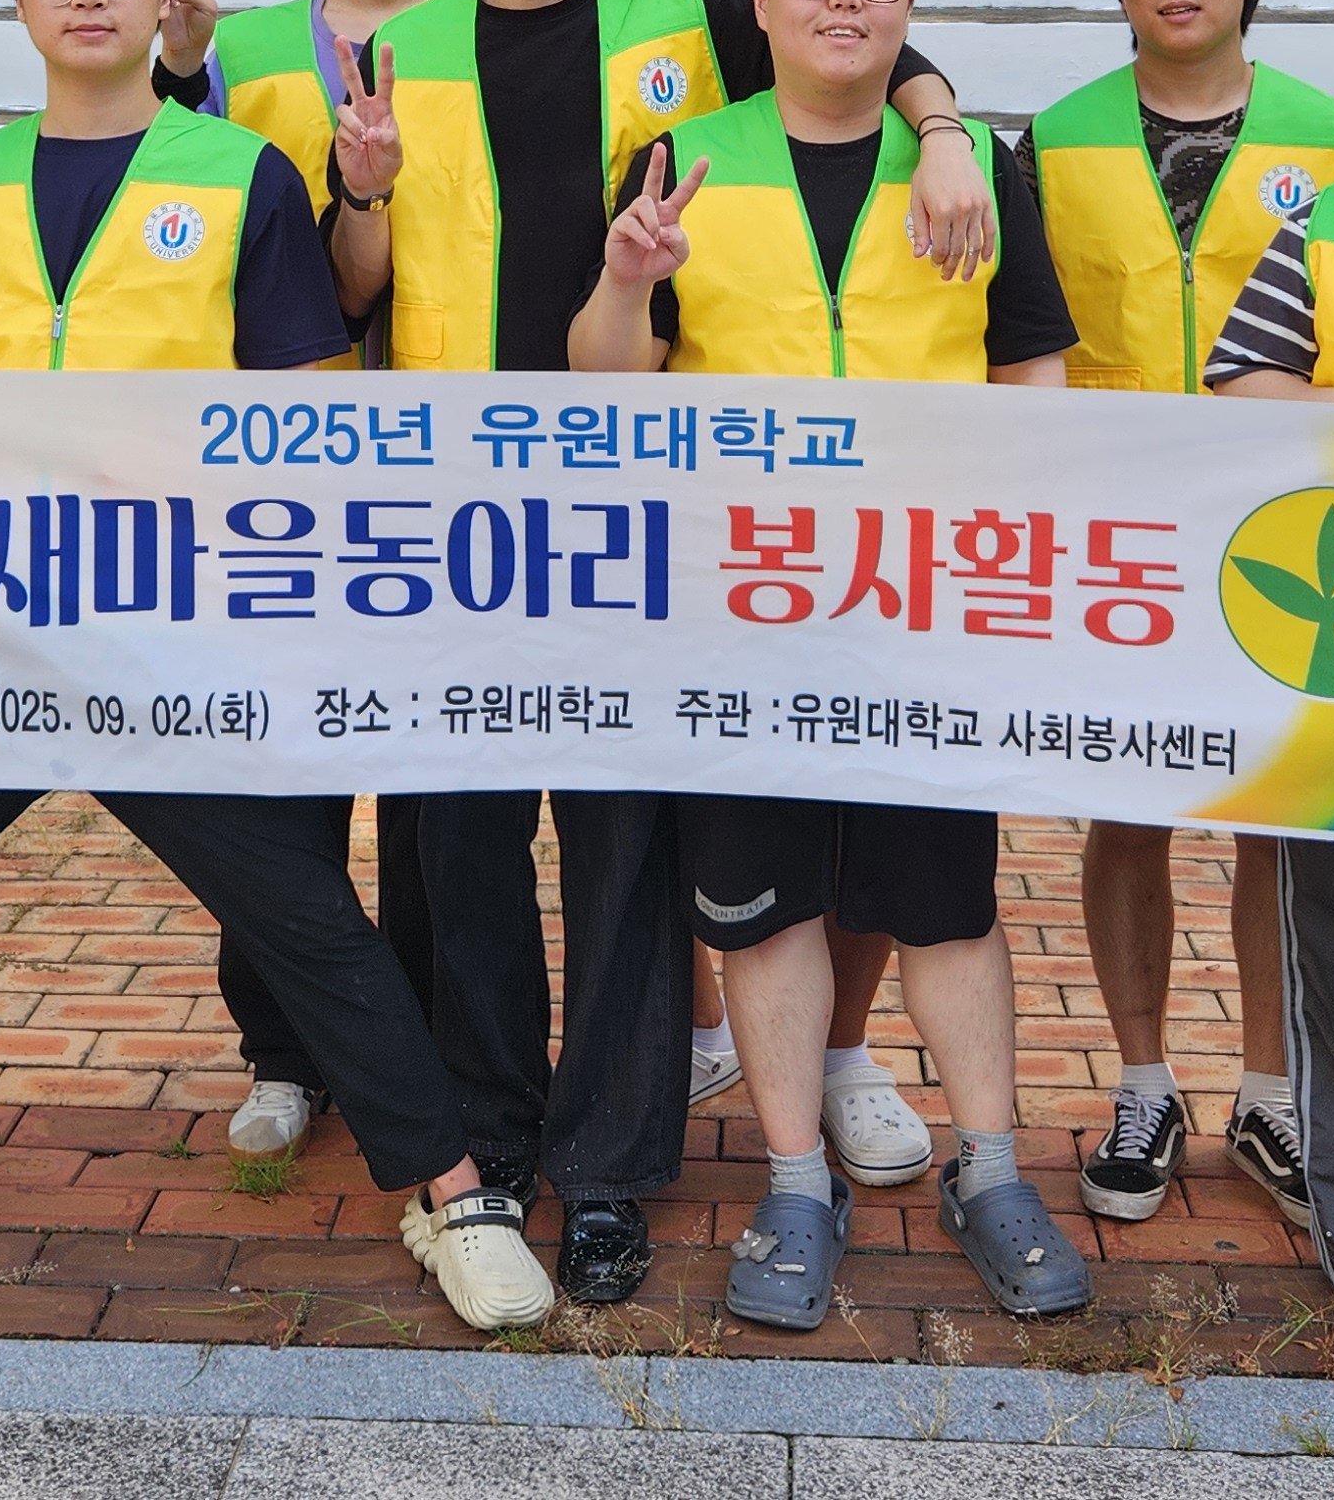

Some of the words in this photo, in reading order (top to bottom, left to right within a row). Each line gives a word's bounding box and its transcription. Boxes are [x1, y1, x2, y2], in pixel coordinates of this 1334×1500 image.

[150, 229, 203, 258] UNIVERSITY
[200, 402, 435, 468] 2025년
[471, 402, 865, 473] 유원대학교
[718, 505, 1185, 647] 봉사활동
[85, 695, 136, 736] 09.
[151, 690, 270, 742] 02.(화)
[314, 687, 391, 738] 장소
[440, 684, 633, 735] 유원대학교
[675, 689, 752, 738] 주관
[998, 710, 1237, 776] 사회봉사센터
